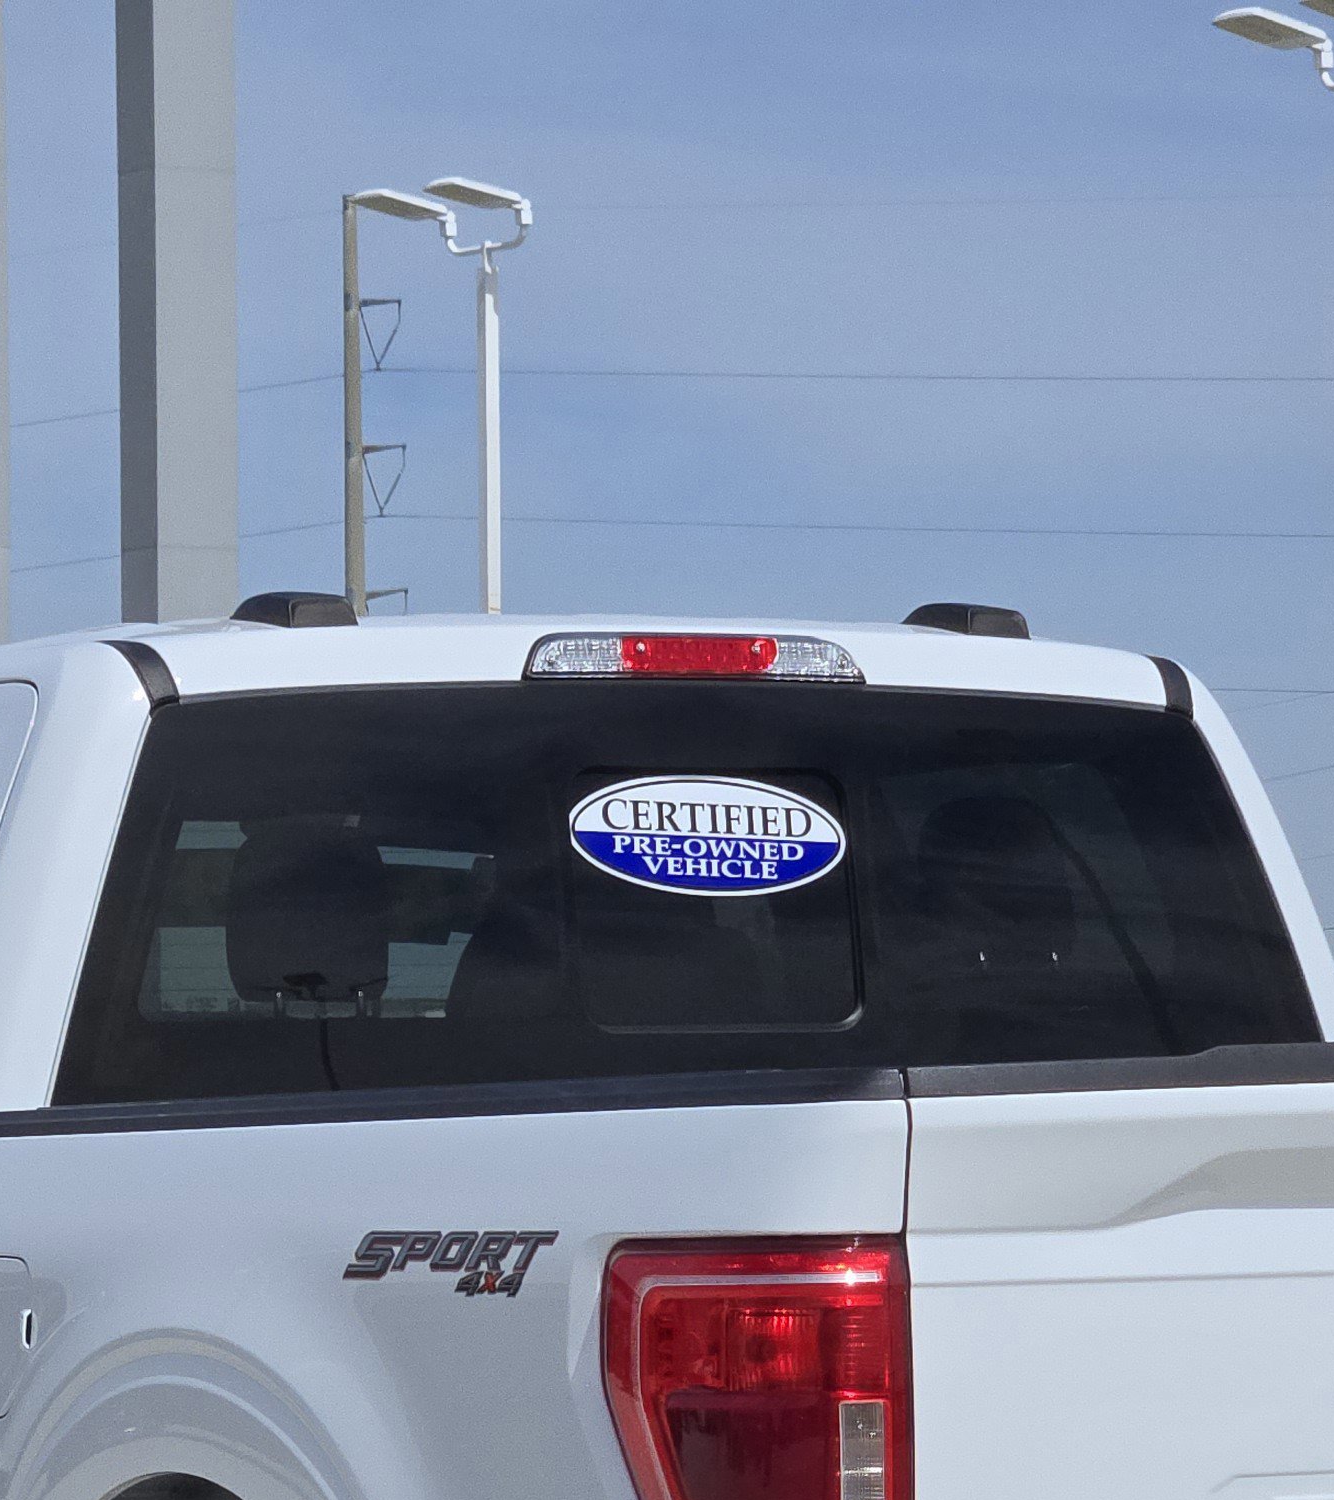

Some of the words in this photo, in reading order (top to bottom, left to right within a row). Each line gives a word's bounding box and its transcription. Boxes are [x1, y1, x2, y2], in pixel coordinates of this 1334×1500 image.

[601, 798, 813, 838] CERTIFIED
[612, 834, 805, 862] PRE-OWNED
[642, 855, 779, 880] VEHICLE
[342, 1229, 560, 1281] SPORT
